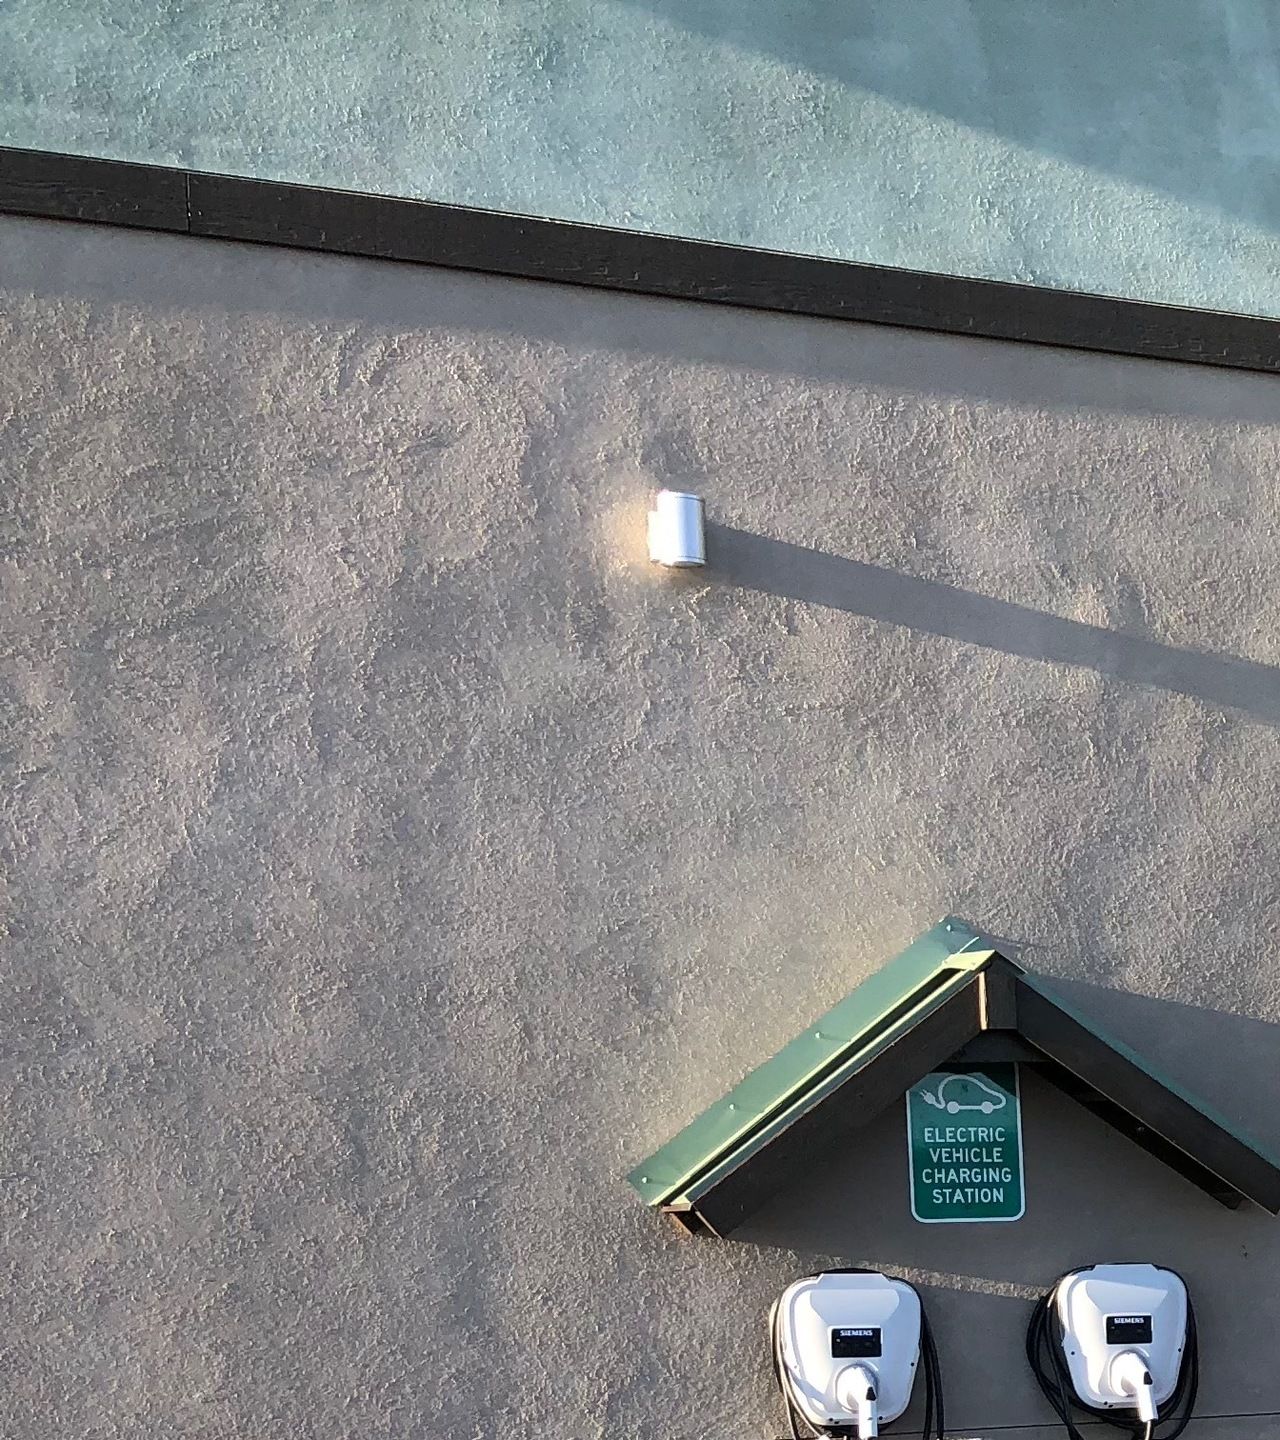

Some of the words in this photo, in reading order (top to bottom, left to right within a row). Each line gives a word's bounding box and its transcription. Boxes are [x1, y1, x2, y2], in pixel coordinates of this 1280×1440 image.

[924, 1128, 1006, 1143] ELECTRIC
[929, 1147, 1004, 1163] VEHICLE
[922, 1167, 1012, 1183] CHARGING
[932, 1188, 1004, 1204] STATION
